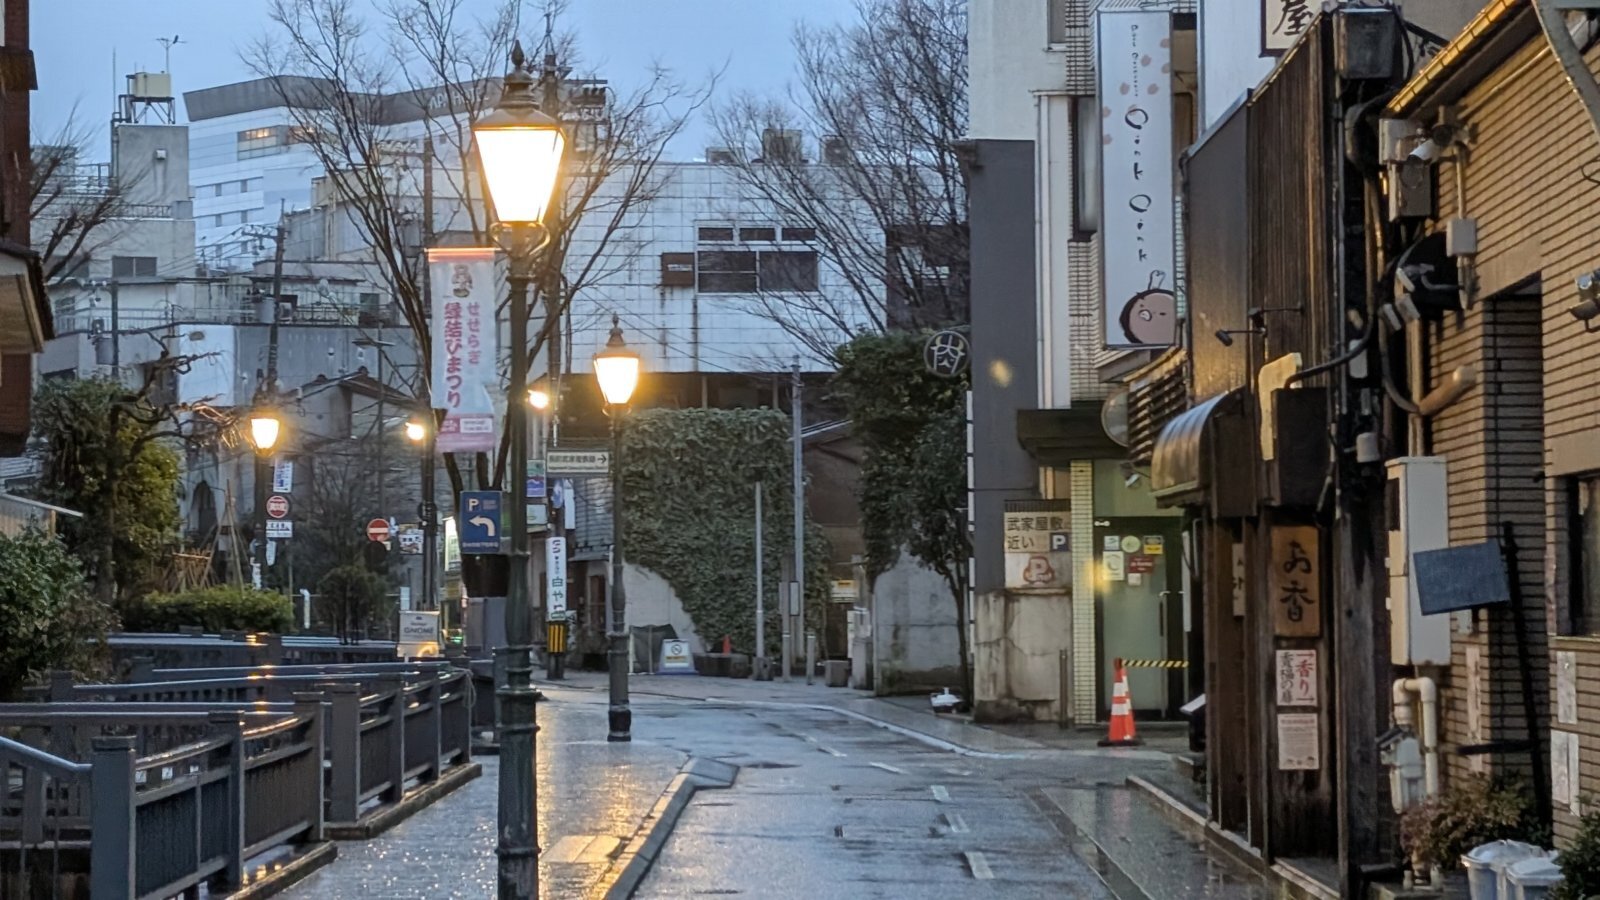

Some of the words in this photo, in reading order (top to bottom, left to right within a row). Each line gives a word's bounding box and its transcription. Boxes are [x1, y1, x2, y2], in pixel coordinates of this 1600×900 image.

[1125, 108, 1149, 180] Oink
[1129, 194, 1152, 262] Oink
[468, 498, 479, 511] P
[1007, 516, 1064, 532] 武家屋敷
[1007, 536, 1035, 550] 近い
[1052, 535, 1066, 549] P
